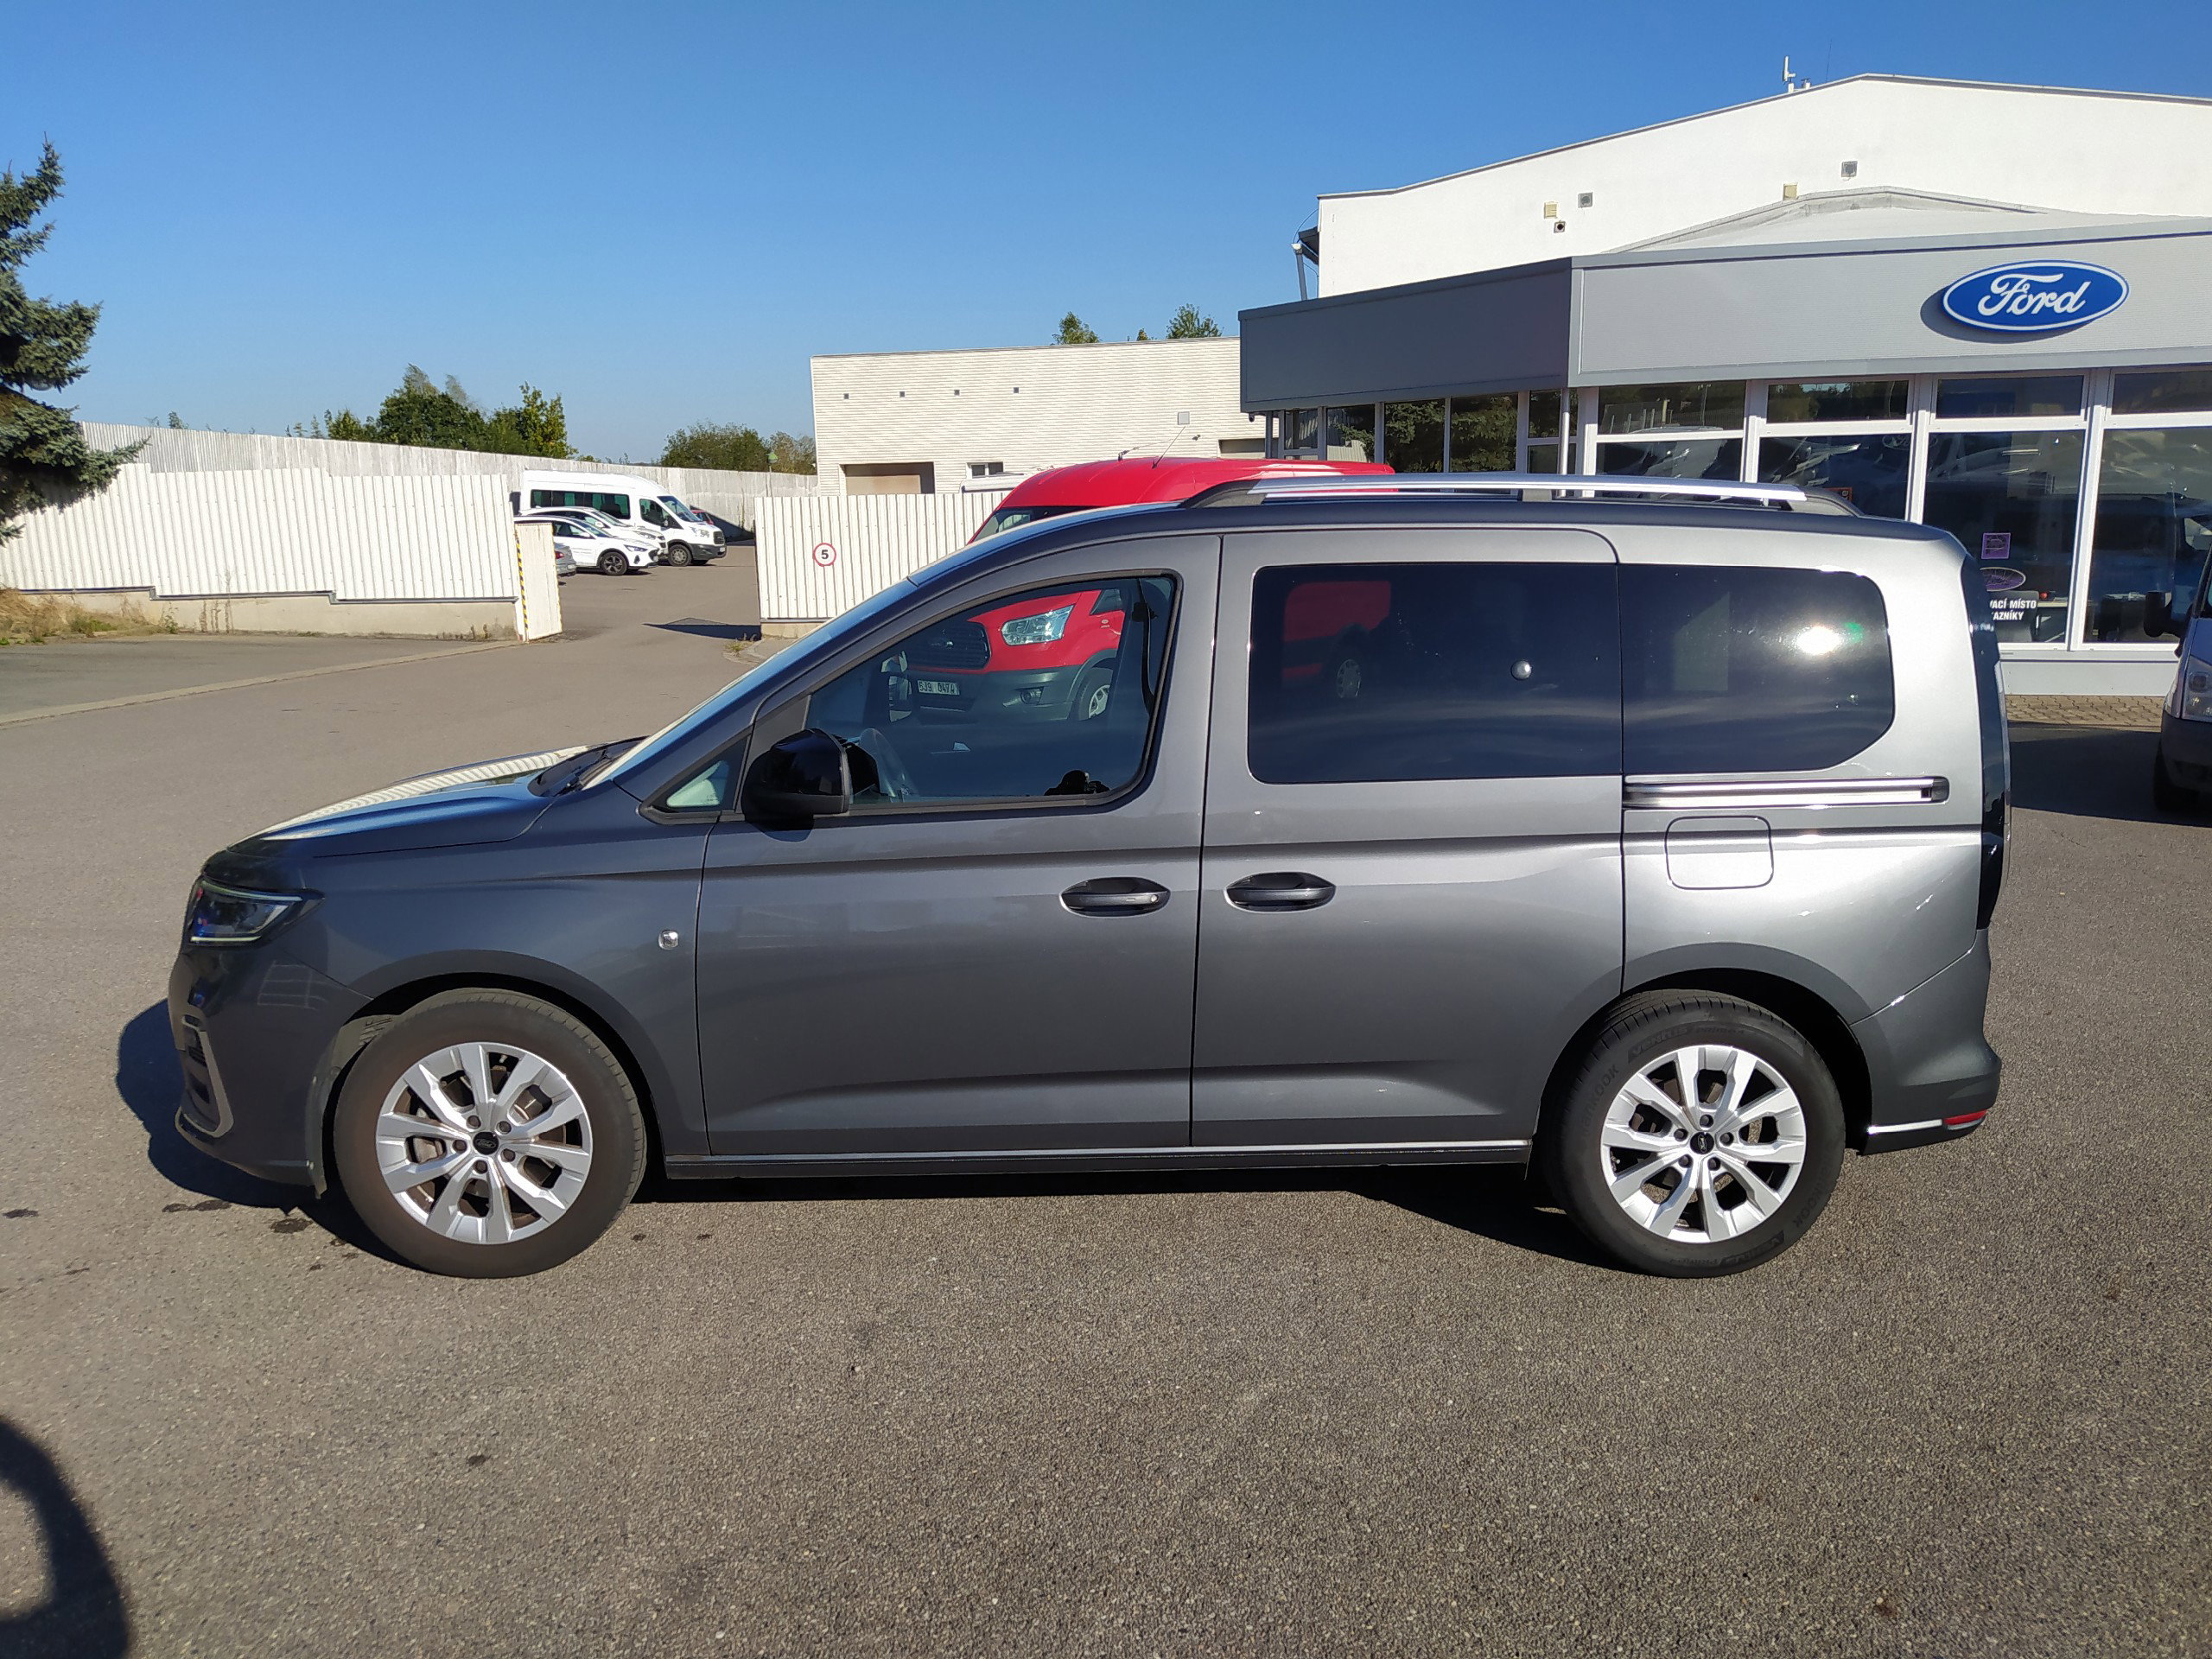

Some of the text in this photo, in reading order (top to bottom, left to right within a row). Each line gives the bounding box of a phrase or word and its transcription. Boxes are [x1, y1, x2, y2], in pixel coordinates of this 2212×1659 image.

[1978, 273, 2092, 316] Ford
[821, 549, 830, 560] 5
[2009, 598, 2037, 609] MÍSTO
[1991, 609, 2024, 620] AZNÍKY
